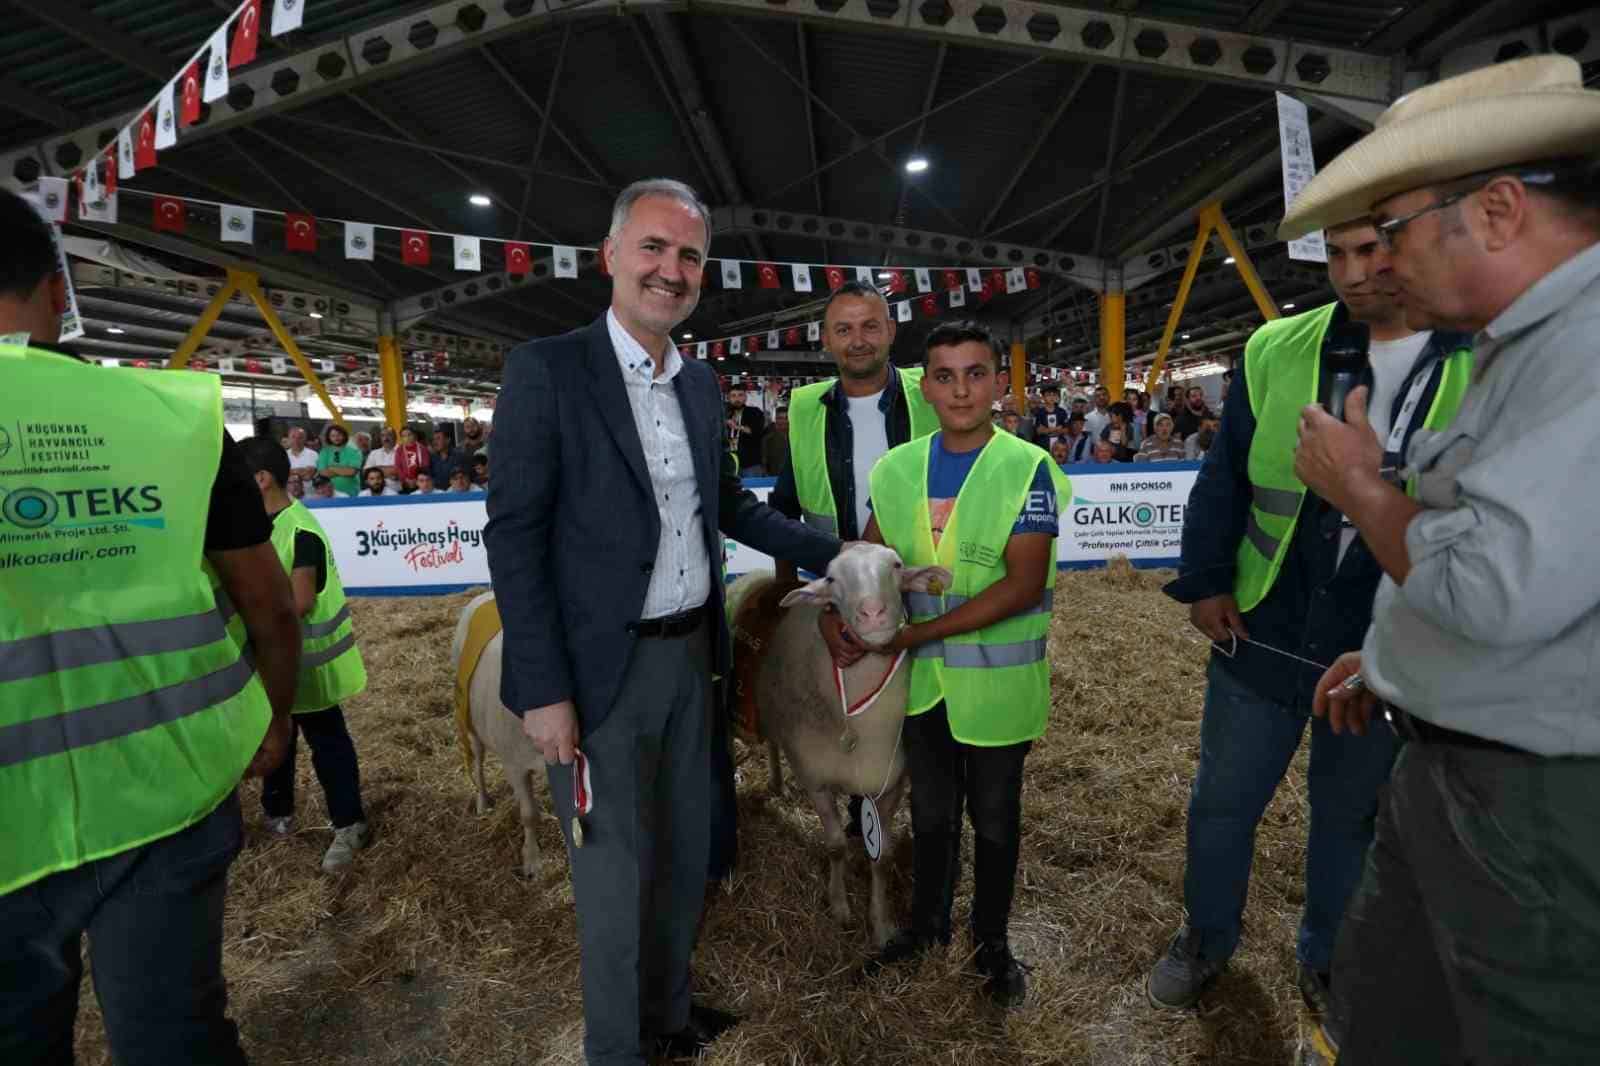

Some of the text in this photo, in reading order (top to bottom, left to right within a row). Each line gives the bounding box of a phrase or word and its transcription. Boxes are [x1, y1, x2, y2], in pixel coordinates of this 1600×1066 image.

[26, 423, 88, 435] KÜÇÜKBAŞ
[29, 437, 105, 448] HAYVANCILIK
[1110, 481, 1172, 491] ANA SPONSOR
[55, 527, 86, 539] Proje
[355, 531, 378, 556] 3.
[370, 528, 446, 550] Küçükbaş
[404, 540, 464, 572] Festivali
[866, 811, 875, 848] 2
